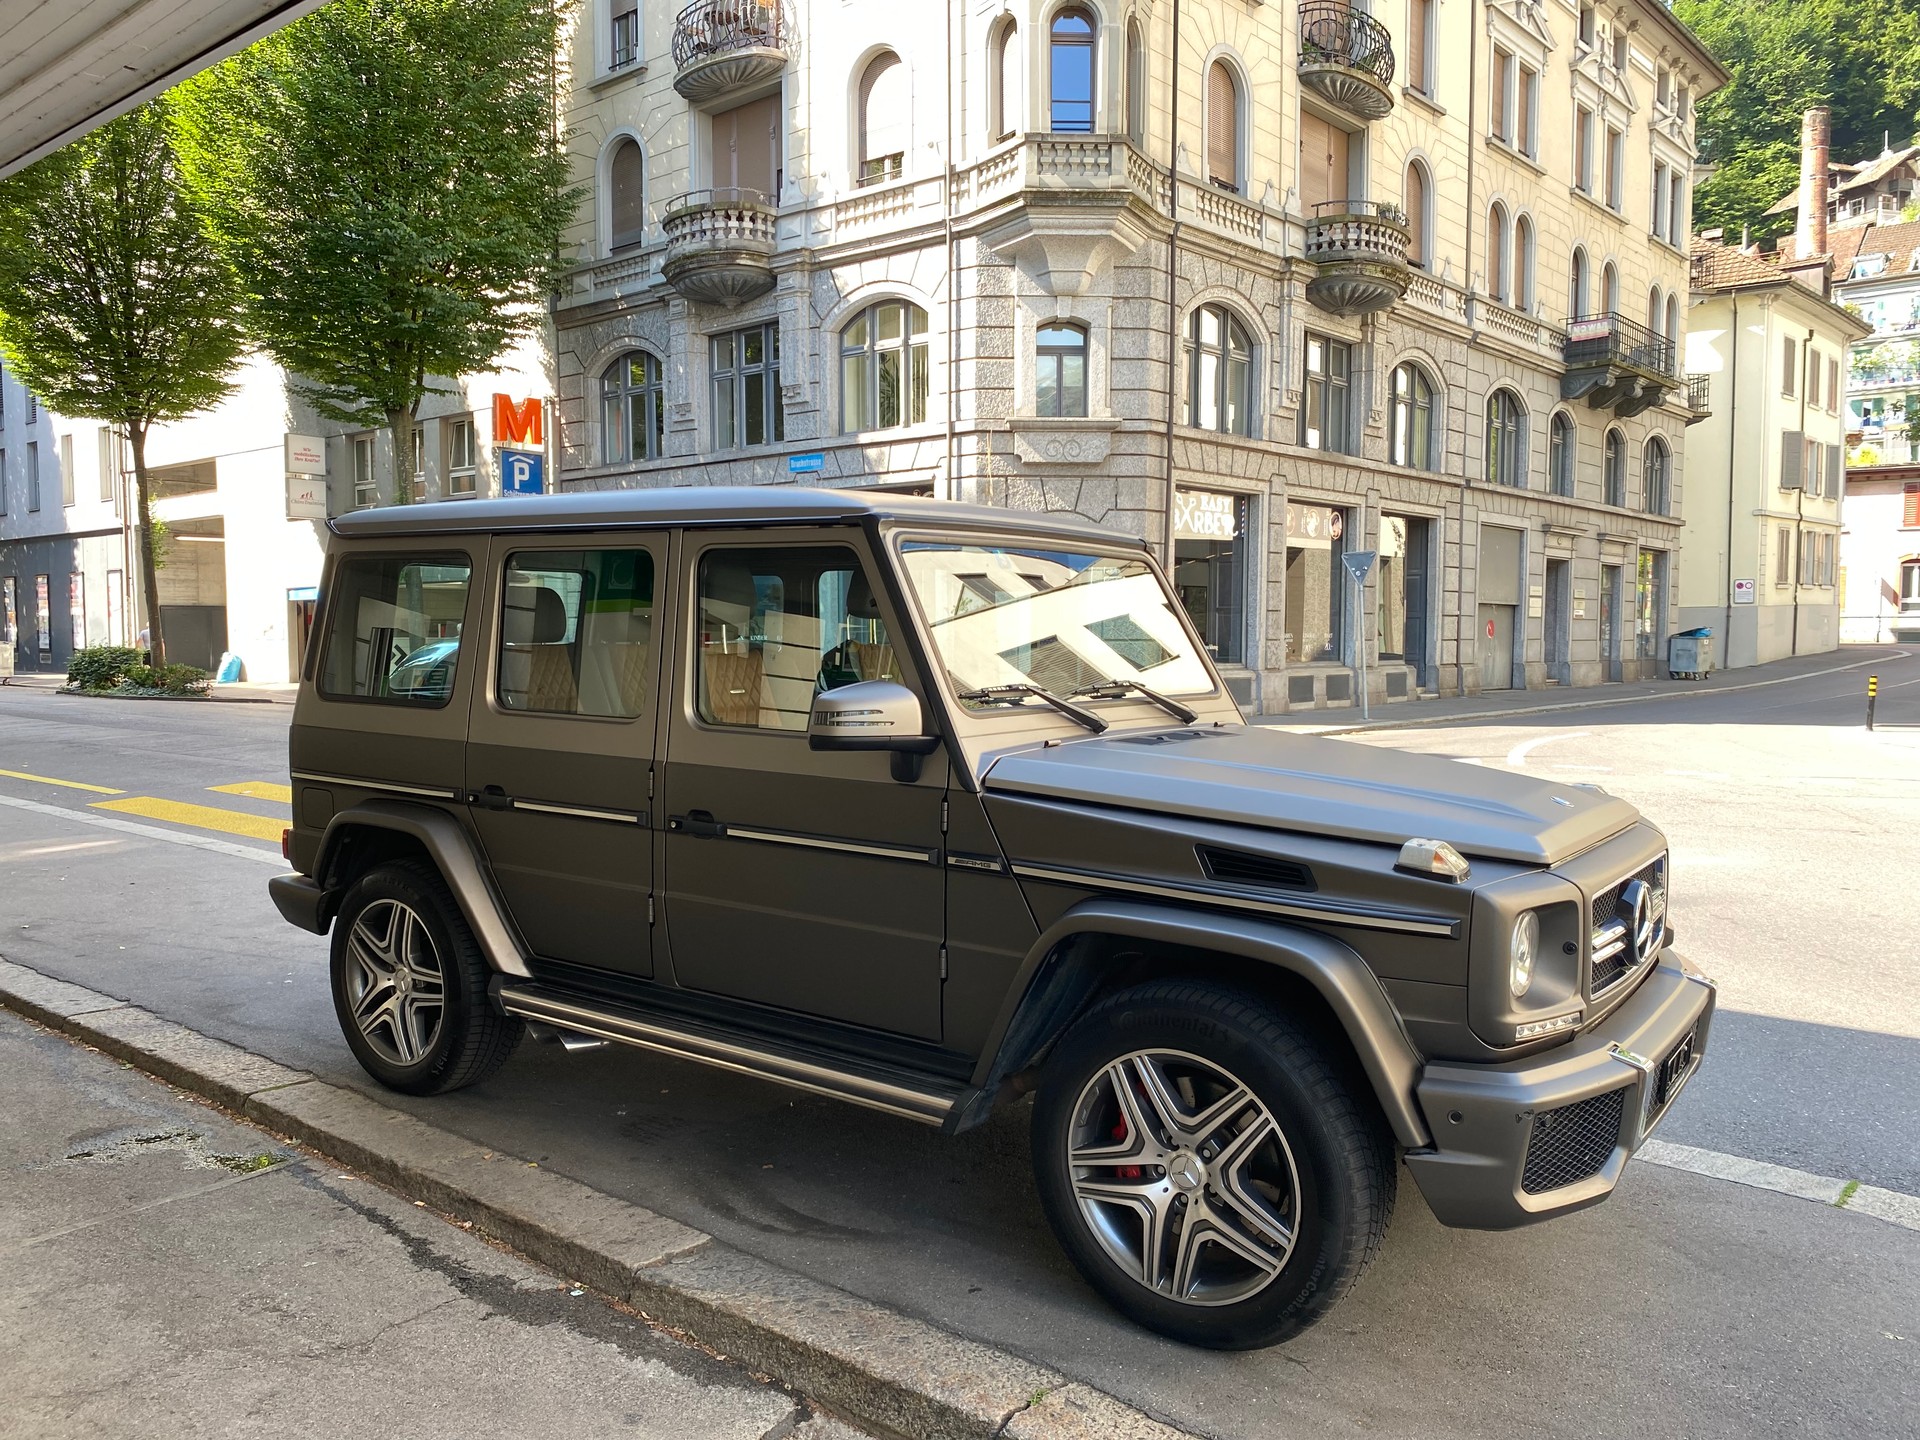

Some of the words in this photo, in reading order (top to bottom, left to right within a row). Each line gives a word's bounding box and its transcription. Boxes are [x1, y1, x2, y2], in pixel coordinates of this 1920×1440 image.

[492, 392, 543, 445] M
[513, 461, 530, 490] P
[1200, 495, 1232, 513] EASY
